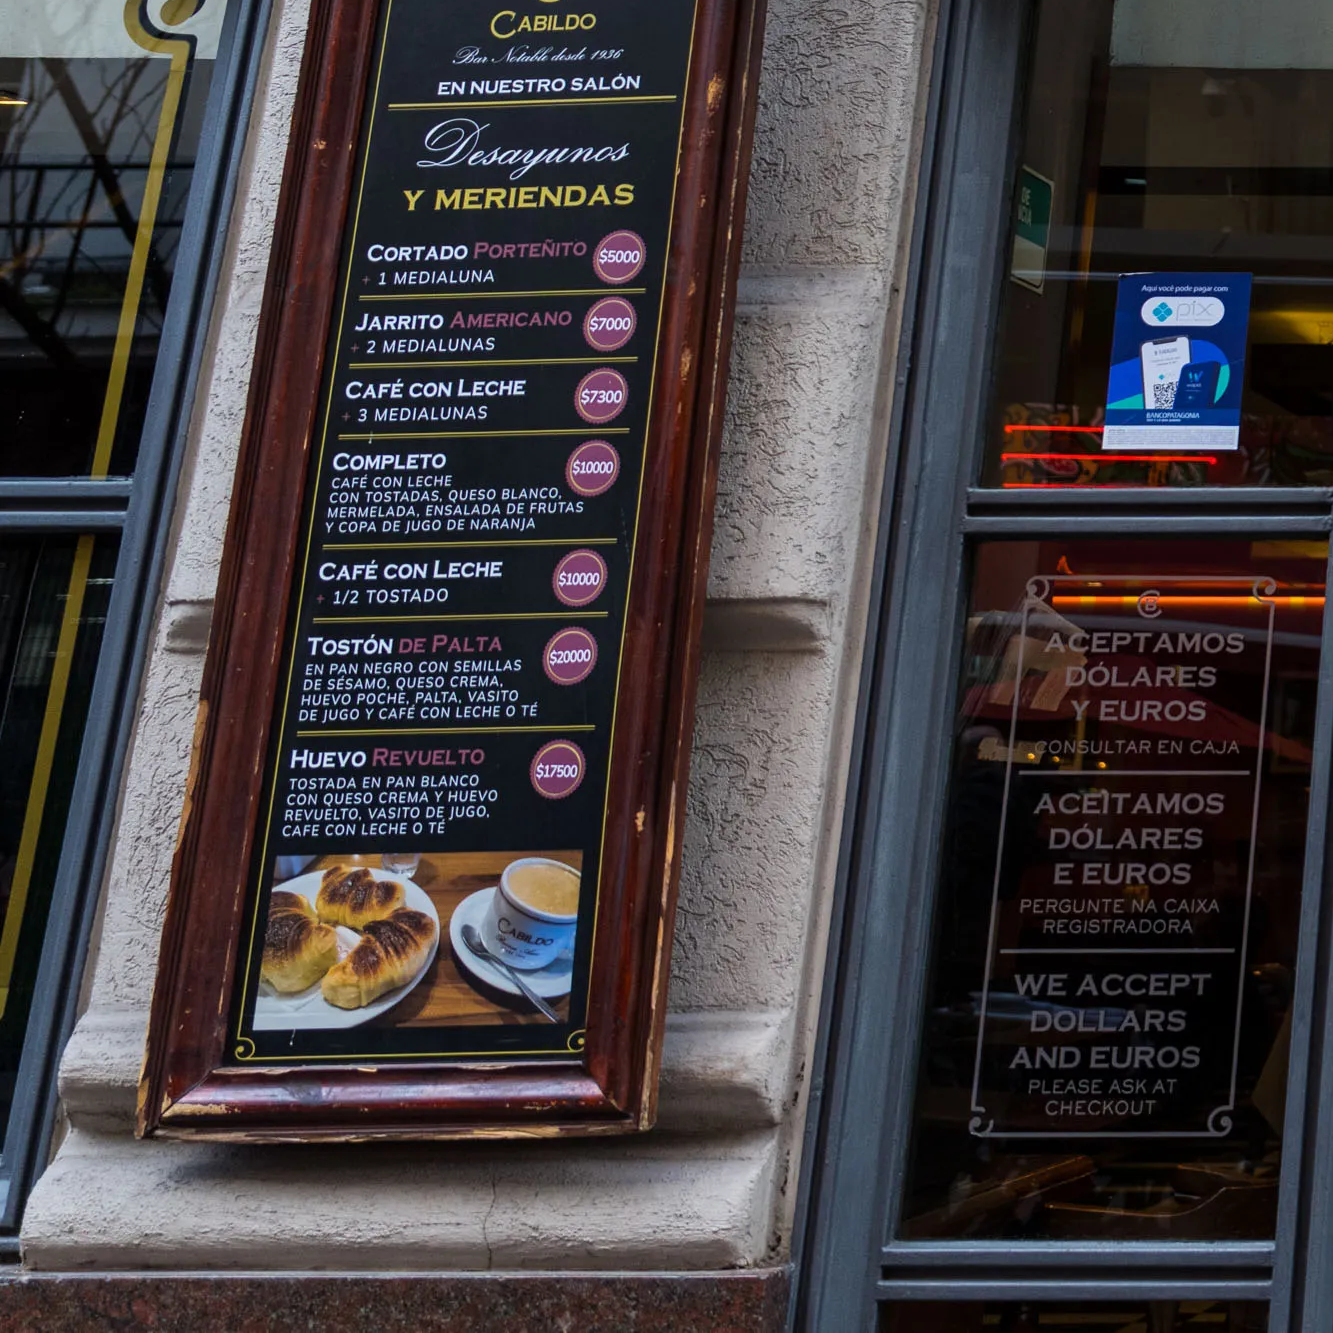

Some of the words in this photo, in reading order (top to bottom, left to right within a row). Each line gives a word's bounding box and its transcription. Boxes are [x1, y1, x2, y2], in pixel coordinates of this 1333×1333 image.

[490, 10, 597, 39] CABILDO
[452, 47, 488, 65] Bar
[492, 47, 550, 65] Notable
[551, 48, 589, 62] desde
[590, 48, 625, 60] 1936
[437, 79, 466, 95] EN
[470, 78, 566, 94] NUESTRO
[570, 72, 641, 92] SALÓN
[416, 117, 630, 181] Desayunos
[403, 189, 427, 211] Y
[434, 184, 635, 210] MERIENDAS
[367, 243, 468, 263] CORTADO
[473, 238, 587, 259] PORTEÑITO
[599, 249, 640, 266] $5000
[378, 272, 387, 286] 1
[393, 269, 495, 285] MEDIALUNA
[1175, 285, 1193, 293] pode
[1194, 286, 1212, 294] pagar
[1177, 299, 1215, 320] pix
[355, 313, 444, 332] JARRITO
[450, 310, 572, 329] AMERICANO
[589, 315, 631, 333] $7000
[366, 340, 377, 354] 2
[382, 338, 496, 353] MEDIALUNAS
[345, 380, 403, 400] CAFÉ
[408, 382, 451, 398] CON
[458, 379, 525, 397] LECHE
[581, 388, 623, 405] $7300
[358, 408, 368, 422] 3
[374, 406, 488, 421] MEDIALUNAS
[332, 452, 446, 471] COMPLETO
[572, 459, 614, 476] $10000
[331, 474, 368, 489] CAFÉ
[371, 475, 403, 488] CON
[407, 474, 453, 487] LECHE
[329, 490, 360, 503] CON
[365, 489, 444, 503] TOSTADAS,
[448, 489, 497, 503] QUESO
[501, 487, 562, 501] BLANCO,
[319, 561, 377, 581] CAFÉ
[383, 563, 428, 580] CON
[432, 560, 502, 579] LECHE
[558, 571, 600, 587] $10000
[332, 590, 359, 605] 1/2
[366, 589, 449, 604] TOSTADO
[308, 635, 394, 655] TOSTÓN
[399, 637, 426, 654] DE
[431, 635, 502, 653] PALTA
[549, 648, 591, 665] $20000
[1044, 631, 1245, 654] ACEPTAMOS
[1066, 661, 1217, 688] DÓLARES
[1071, 700, 1091, 721] Y
[1100, 699, 1207, 722] EUROS
[1035, 740, 1152, 755] CONSULTAR
[1158, 740, 1184, 754] EN
[1190, 740, 1240, 755] CAJA
[291, 749, 366, 769] HUEVO
[371, 747, 485, 767] REVUELTO
[535, 763, 578, 780] $17500
[1049, 823, 1203, 850] DÓLARES
[1053, 864, 1073, 885] E
[1082, 863, 1192, 885] EUROS
[1020, 899, 1124, 914] PERGUNTE
[1131, 899, 1158, 913] NA
[1164, 899, 1220, 913] CAIXA
[1043, 920, 1193, 934] REGISTRADORA
[1015, 974, 1068, 996] WE
[1076, 973, 1212, 995] ACCEPT
[1030, 1010, 1187, 1032] DOLLARS
[1009, 1047, 1081, 1069] AND
[1090, 1046, 1200, 1068] EUROS
[1028, 1079, 1102, 1094] PLEASE
[1109, 1079, 1147, 1094] ASK
[1152, 1079, 1177, 1093] AT
[1045, 1100, 1156, 1115] CHECKOUT
